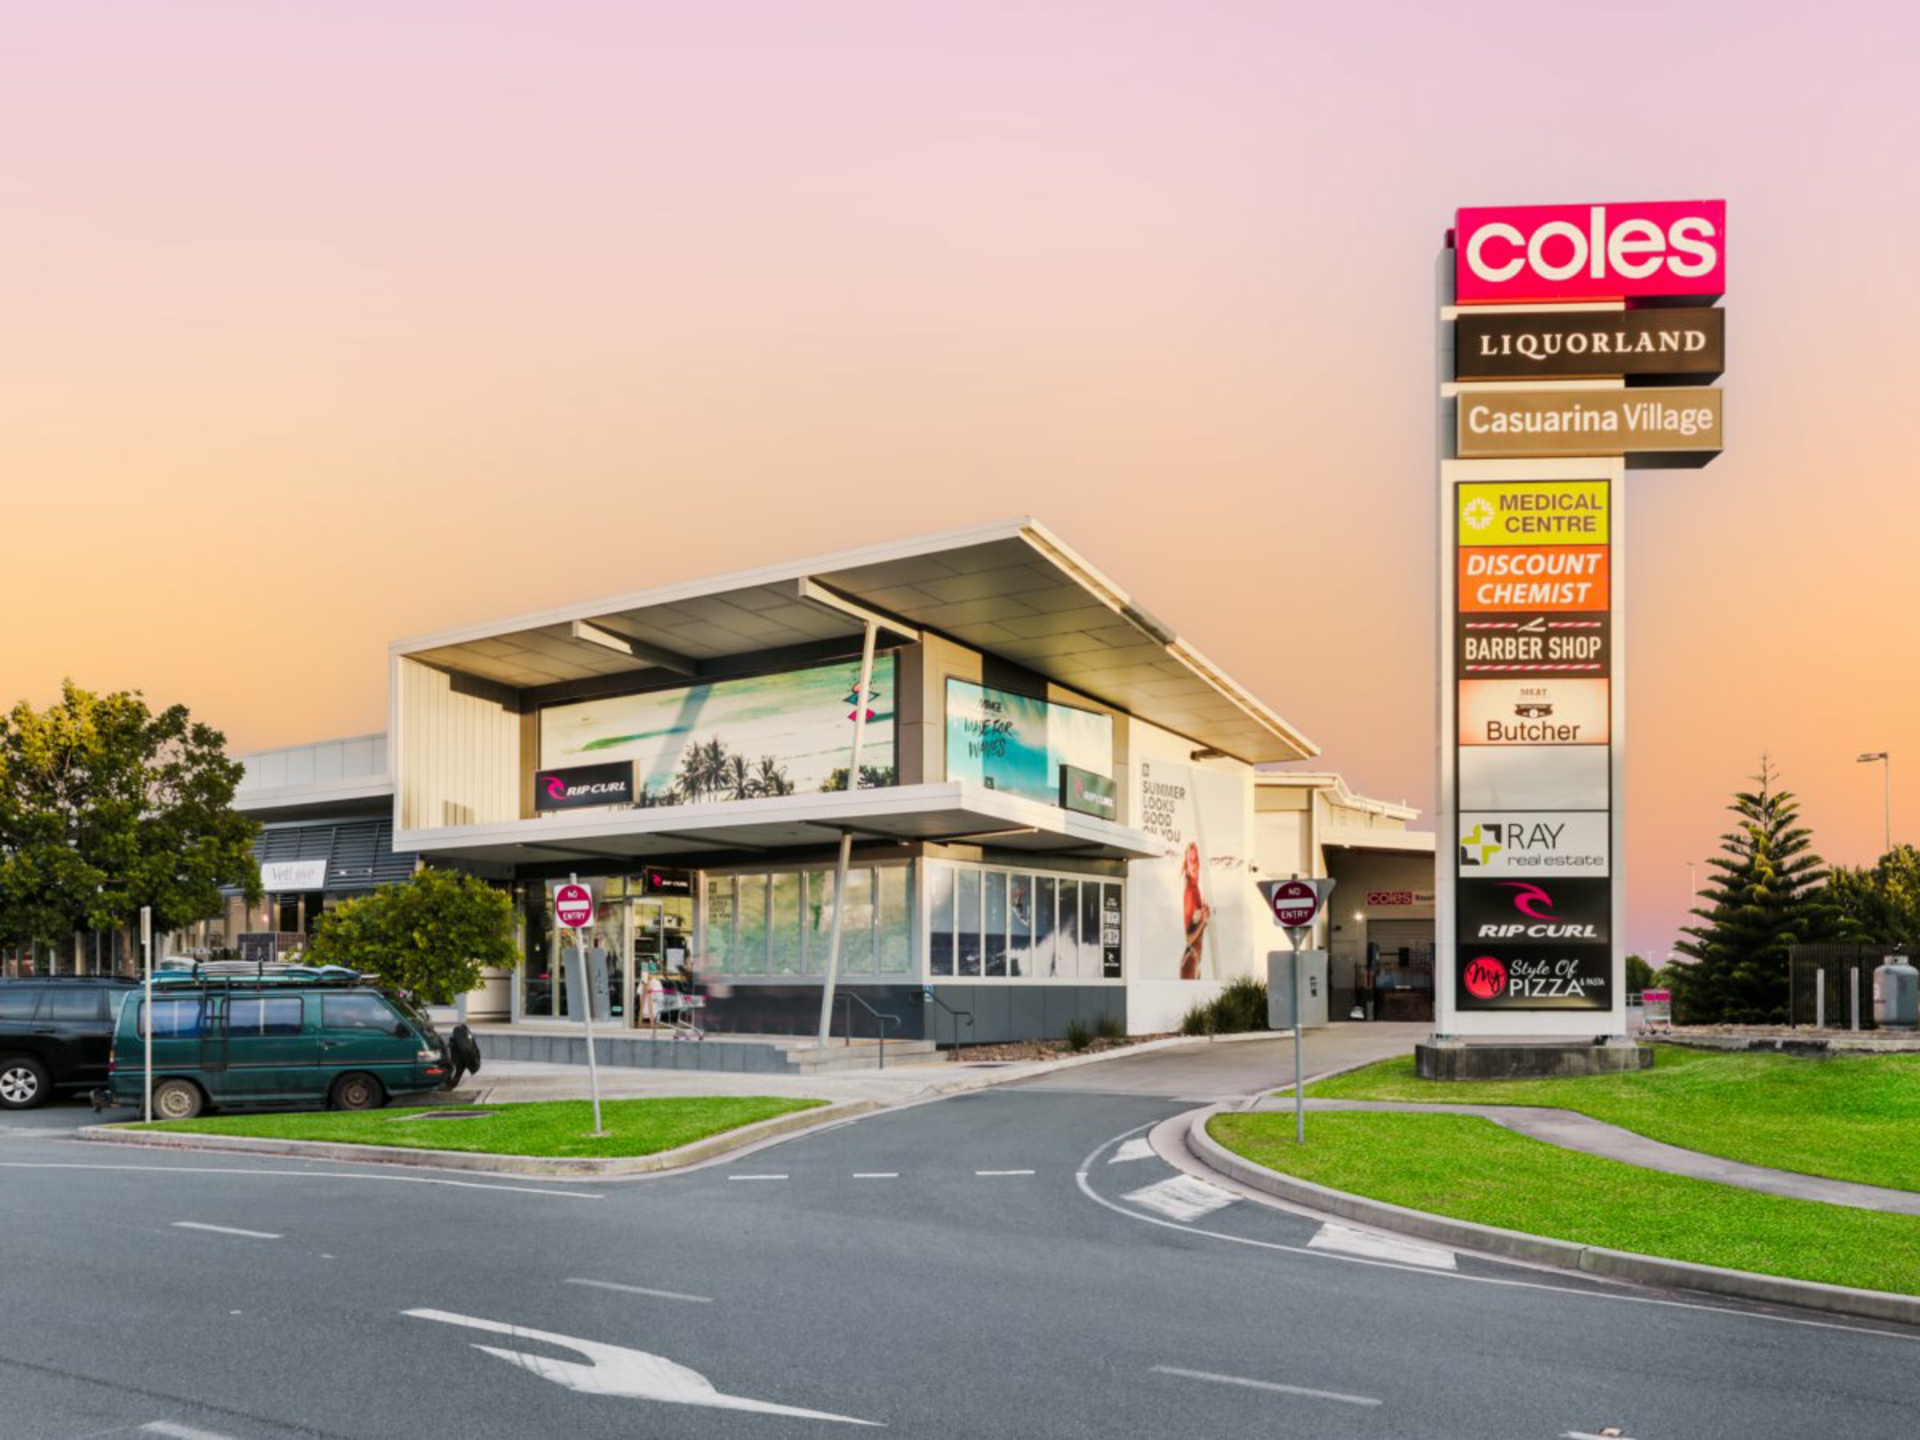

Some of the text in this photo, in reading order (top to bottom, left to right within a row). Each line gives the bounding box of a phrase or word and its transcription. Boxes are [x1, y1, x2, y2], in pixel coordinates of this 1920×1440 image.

[1466, 206, 1717, 282] coles
[1480, 330, 1706, 360] LIQUORLAND
[1469, 402, 1713, 435] Casuarina Village
[1500, 493, 1603, 511] MEDICAL
[1505, 516, 1597, 533] CENTRE
[1467, 553, 1602, 576] DISCOUNT
[1477, 582, 1592, 604] CHEMIST
[1465, 636, 1602, 660] BARBER SHOP
[1487, 720, 1581, 741] Butcher
[566, 782, 626, 796] RIP CURL
[1142, 780, 1185, 799] SUMMER
[1143, 797, 1175, 813] LOOKS
[1143, 811, 1172, 827] GOOD
[1508, 823, 1564, 849] RAY
[1508, 856, 1604, 866] real estate
[567, 890, 577, 898] NO
[1288, 888, 1300, 896] NO
[1368, 892, 1411, 905] coles
[562, 912, 586, 921] ENTRY
[1281, 910, 1309, 919] ENTRY
[1478, 925, 1597, 937] RIP CURL
[1510, 960, 1578, 979] Style Of
[1510, 979, 1585, 997] PIZZA
